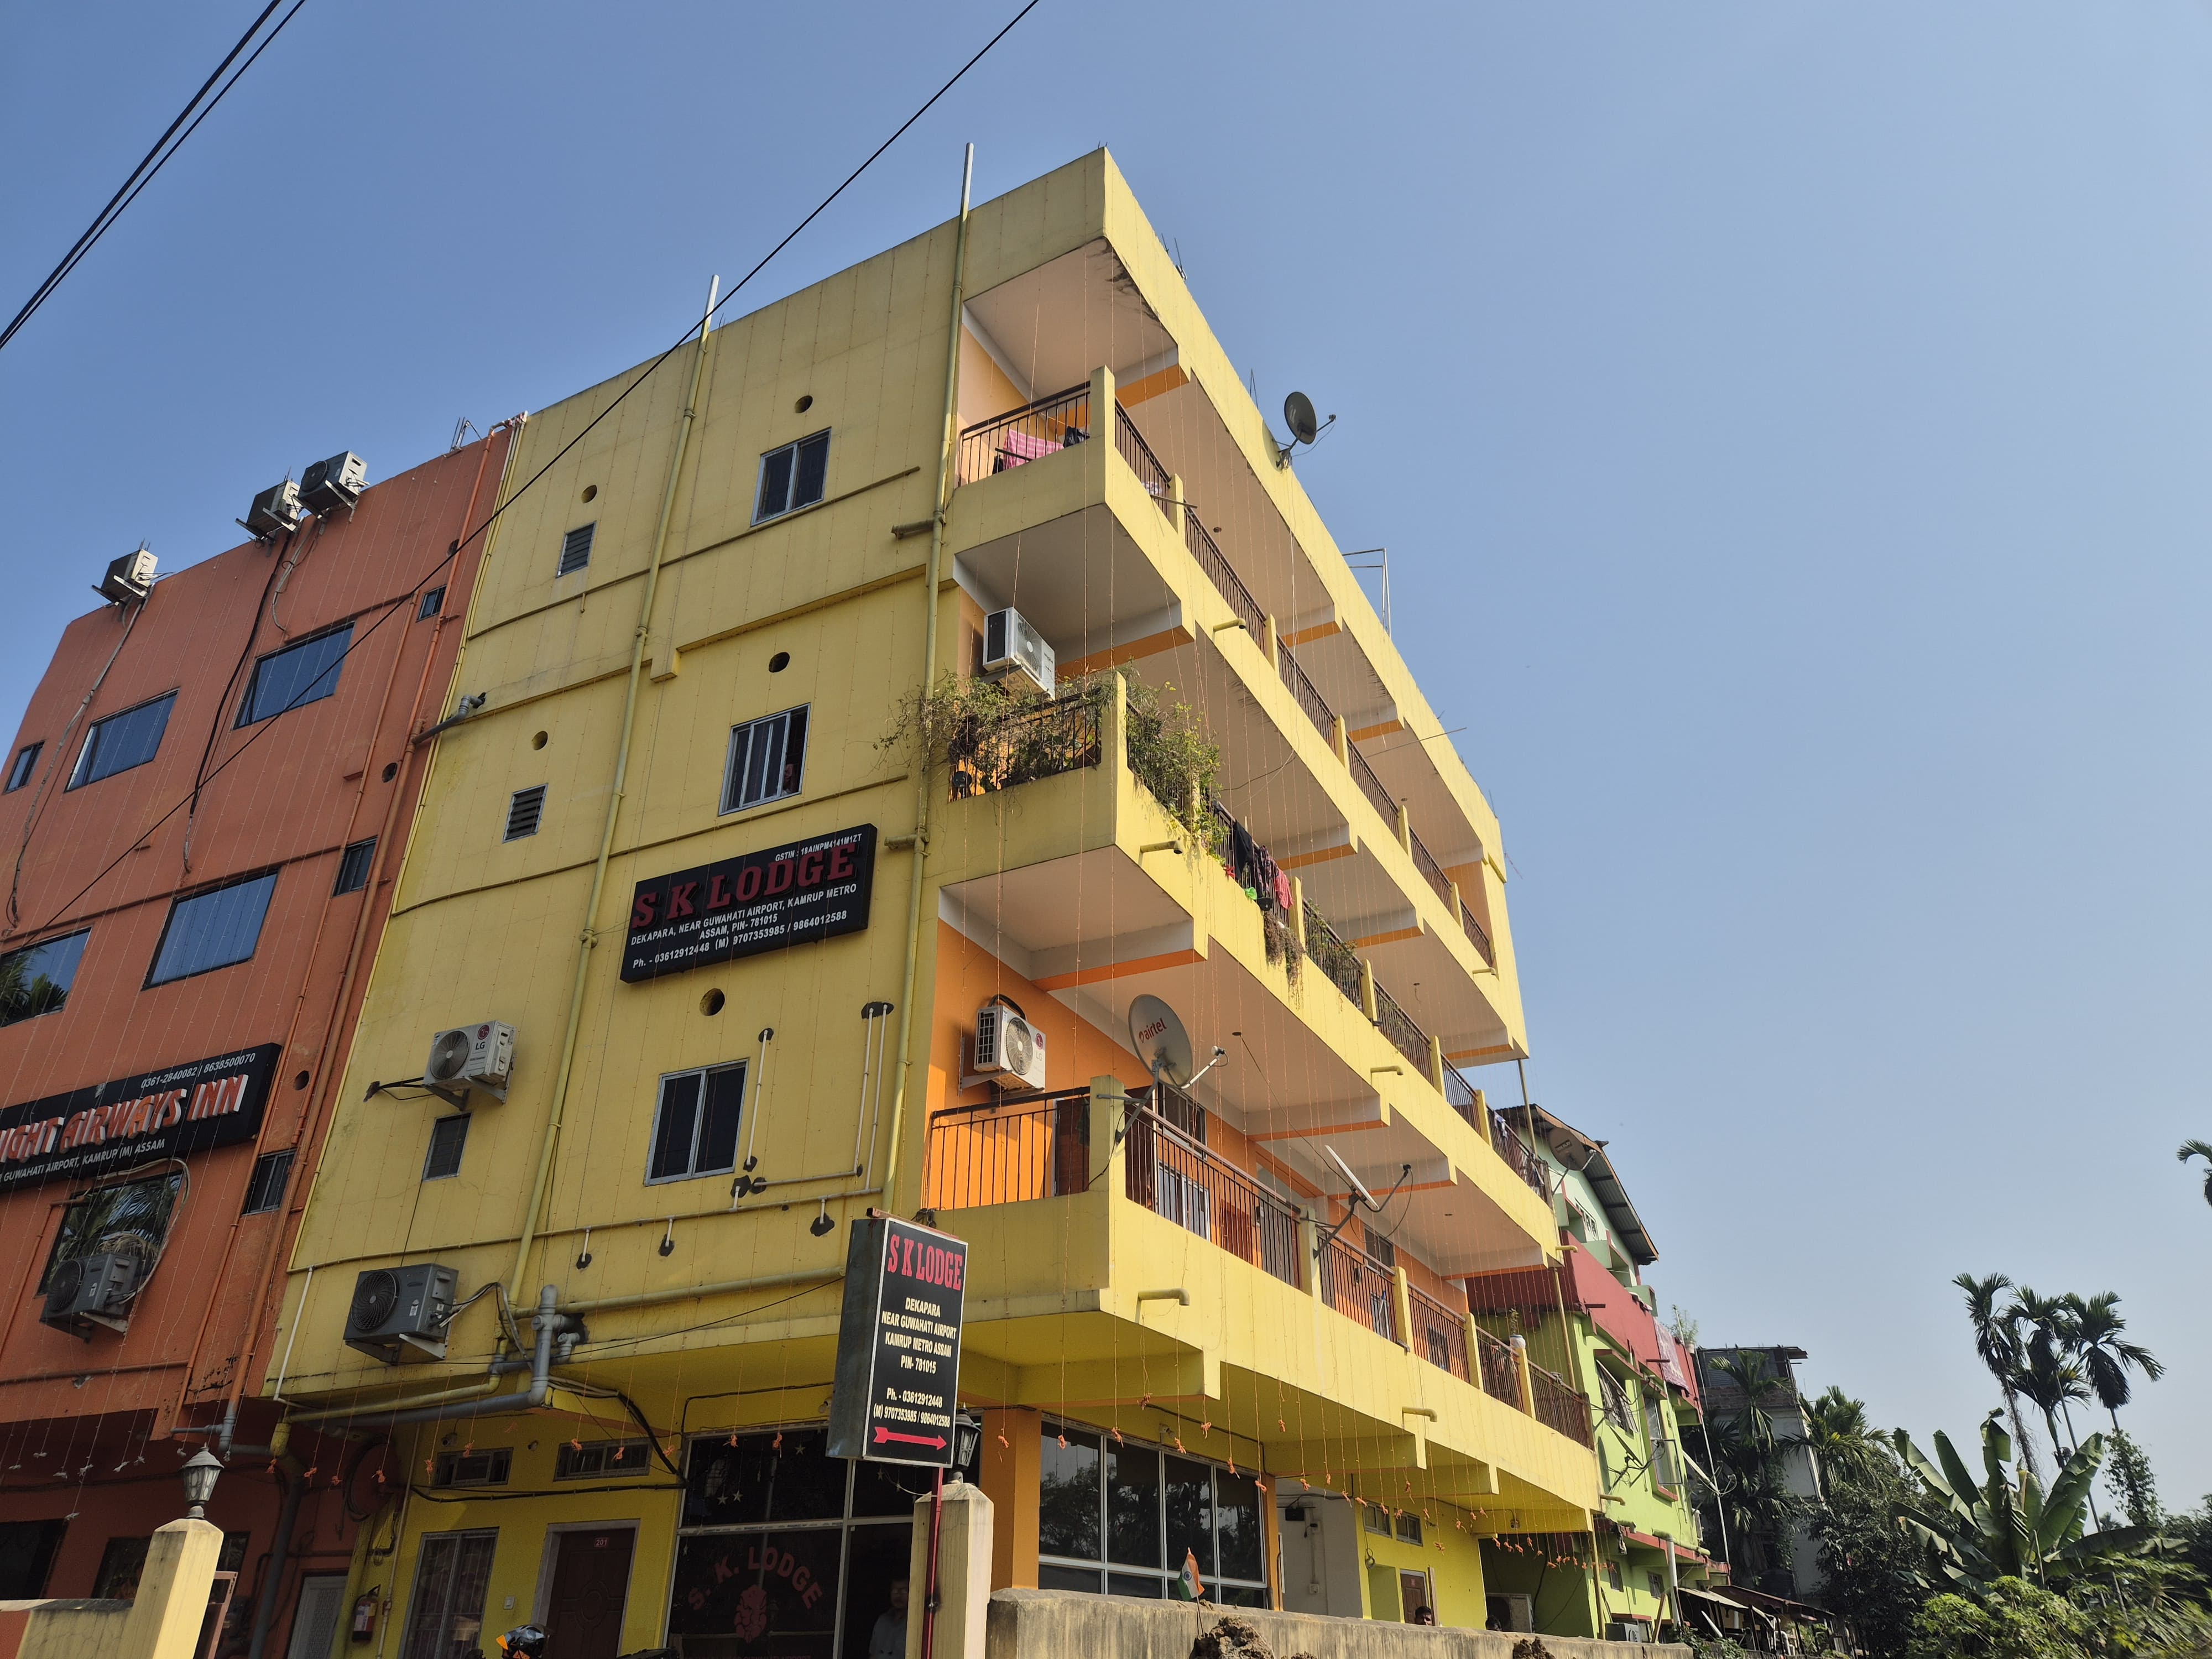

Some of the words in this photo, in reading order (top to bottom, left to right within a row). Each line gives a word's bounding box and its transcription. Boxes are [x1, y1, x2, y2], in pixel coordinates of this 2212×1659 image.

[775, 850, 795, 862] GSTIN
[632, 892, 657, 929] S
[666, 881, 697, 920] K
[707, 843, 855, 910] LODGE
[631, 927, 676, 946] DEKAPARA,
[679, 920, 701, 934] NEAR
[703, 910, 745, 927] GUWAHATI
[747, 900, 785, 917] AIRPORT,
[787, 891, 824, 908] KAMRUP
[826, 883, 857, 899] METRO
[699, 925, 729, 940] ASSAM,
[750, 913, 778, 927] 781015
[633, 958, 646, 968] Ph.
[655, 942, 709, 963] 03612912448
[715, 937, 729, 950] (M)
[733, 925, 785, 945] 9707353985
[793, 910, 847, 931] 9864012588
[1144, 1018, 1167, 1040] airtel
[475, 1041, 485, 1050] LG
[140, 1067, 197, 1088] 0361-2840082
[204, 1052, 256, 1073] 8638500070
[0, 1117, 65, 1164] IGHT
[59, 1088, 187, 1154] AIRWAYS
[186, 1074, 249, 1121] INN
[3, 1165, 45, 1182] GUWAHATI
[45, 1157, 80, 1172] AIRPORT,
[82, 1149, 118, 1165] KAMRUP
[119, 1145, 133, 1159] (M)
[134, 1138, 165, 1154] ASSAM
[887, 1234, 900, 1273] S
[901, 1238, 914, 1277] K
[916, 1243, 963, 1291] LODGE
[905, 1297, 940, 1318] DEKAPARA
[881, 1311, 900, 1327] NEAR
[900, 1315, 933, 1334] GUWAHATI
[933, 1323, 957, 1340] AIRPORT
[885, 1332, 912, 1349] KAMRUP
[912, 1337, 933, 1354] METRO
[933, 1342, 952, 1358] ASSAM
[915, 1358, 937, 1374] 781015
[886, 1387, 897, 1400] Ph.
[902, 1390, 943, 1408] 03612912448
[873, 1403, 883, 1419] (M)
[884, 1406, 917, 1423] 9707353985
[920, 1412, 951, 1428] 9864012588
[747, 1547, 823, 1610] LODGE
